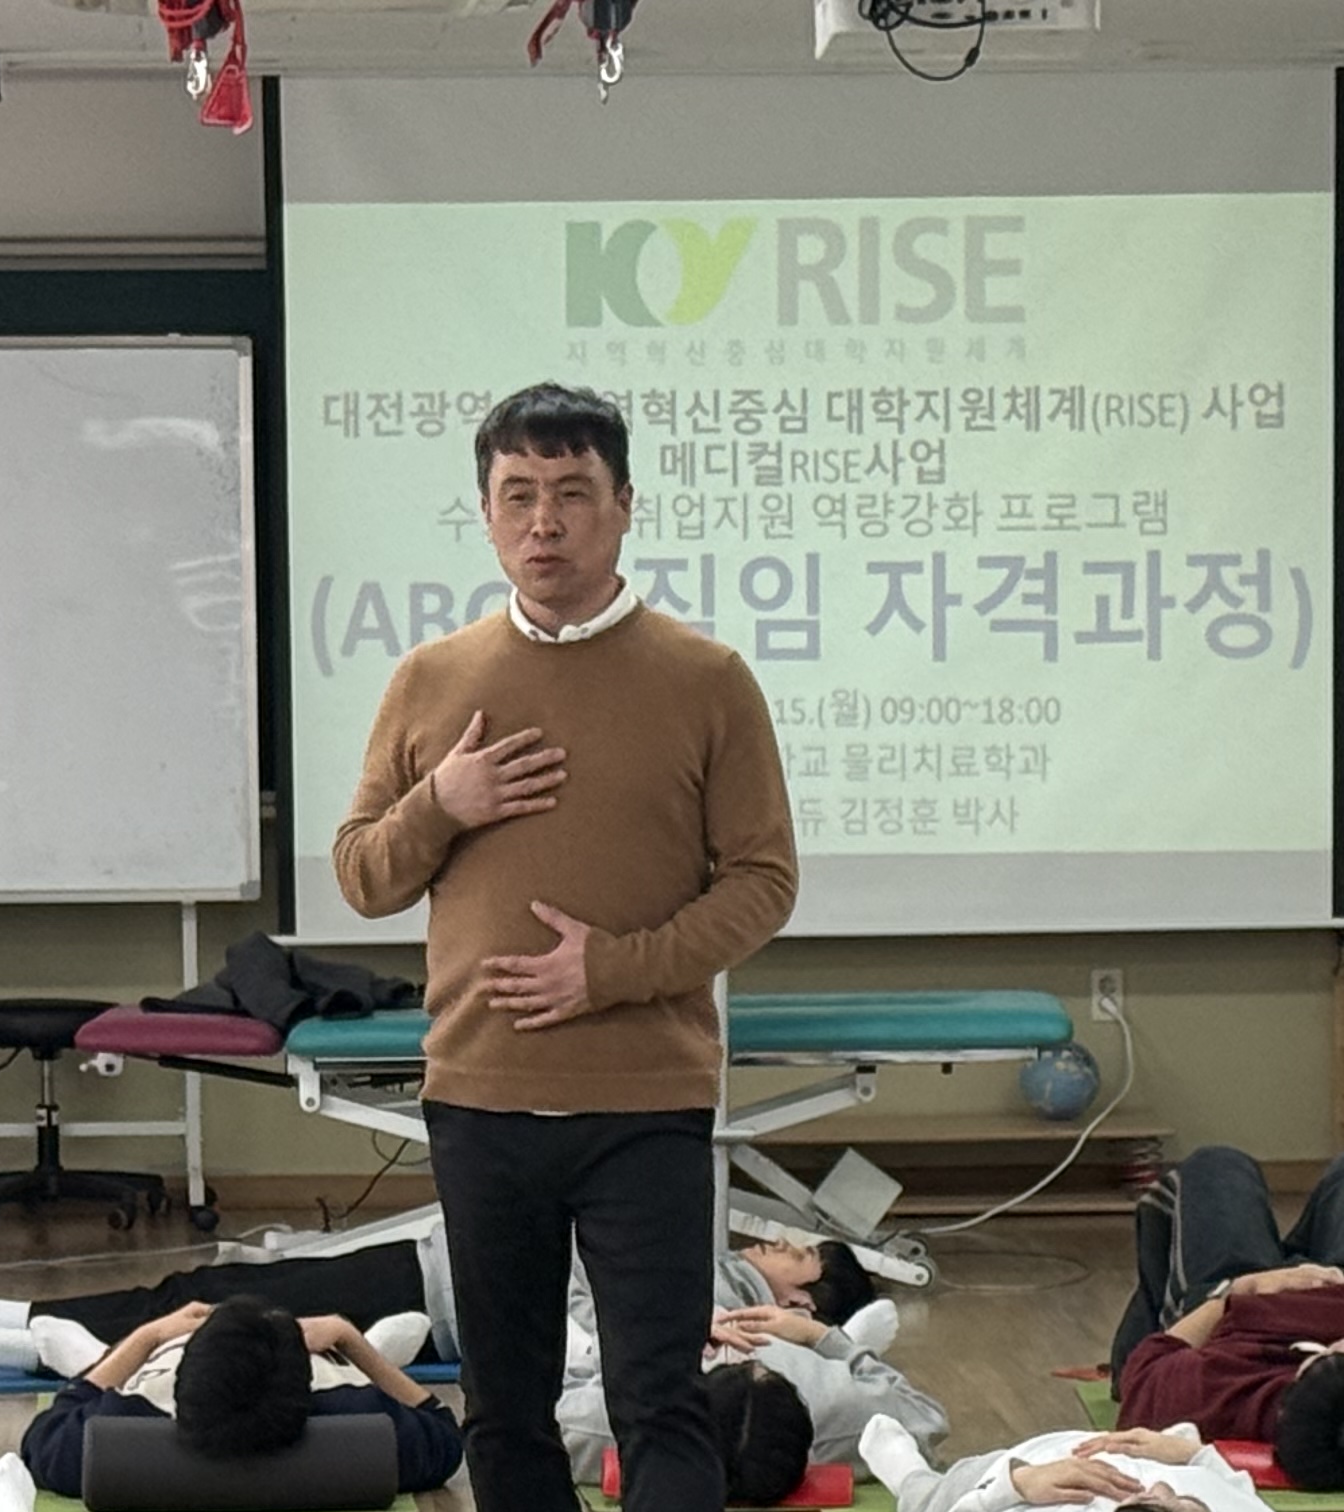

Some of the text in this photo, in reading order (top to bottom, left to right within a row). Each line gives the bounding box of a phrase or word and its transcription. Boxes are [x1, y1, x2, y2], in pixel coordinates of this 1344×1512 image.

[775, 214, 1027, 326] RISE
[322, 381, 1285, 440] 대전광역 역혁신중심 대학지원체계(RISE) 사업
[659, 437, 947, 488] 메디컬RISE사업
[811, 492, 984, 540] 역량강화
[995, 490, 1168, 537] 프로그램
[863, 547, 1314, 670] 자격과정)
[880, 695, 1062, 726] 09:00~18:00
[839, 741, 1052, 782] 물리치료학과
[840, 796, 942, 838] 김정훈
[952, 793, 1021, 834] 박사
